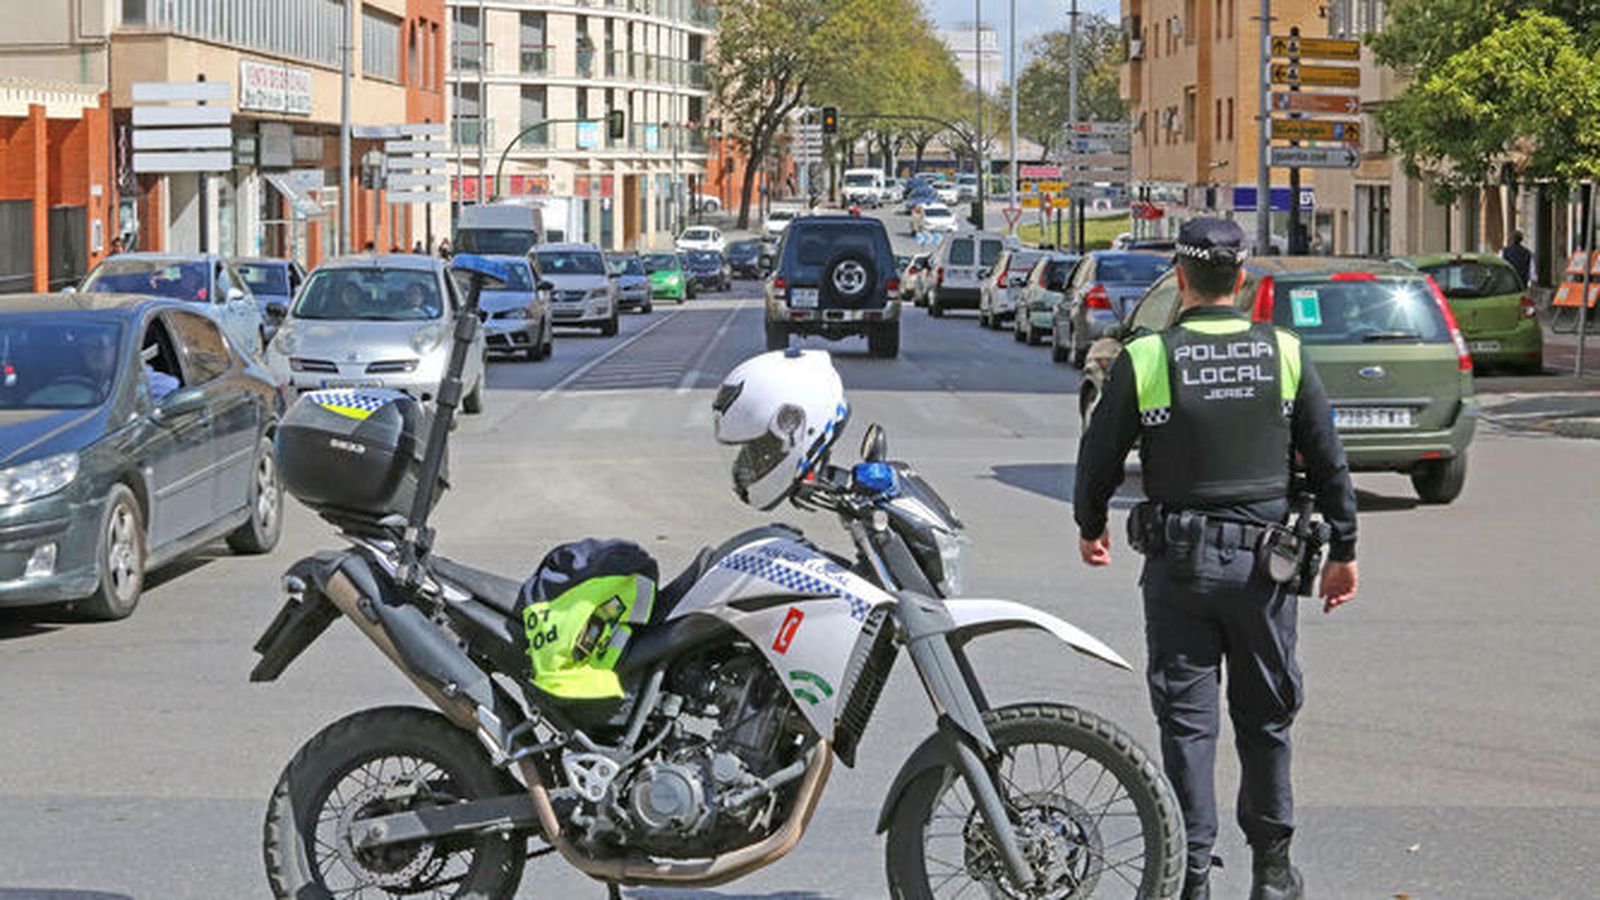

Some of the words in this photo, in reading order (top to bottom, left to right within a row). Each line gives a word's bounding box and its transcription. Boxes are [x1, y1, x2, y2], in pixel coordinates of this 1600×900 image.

[1174, 342, 1273, 362] POLICIA
[1182, 364, 1274, 385] LOCAL
[1203, 387, 1255, 400] JEREZ
